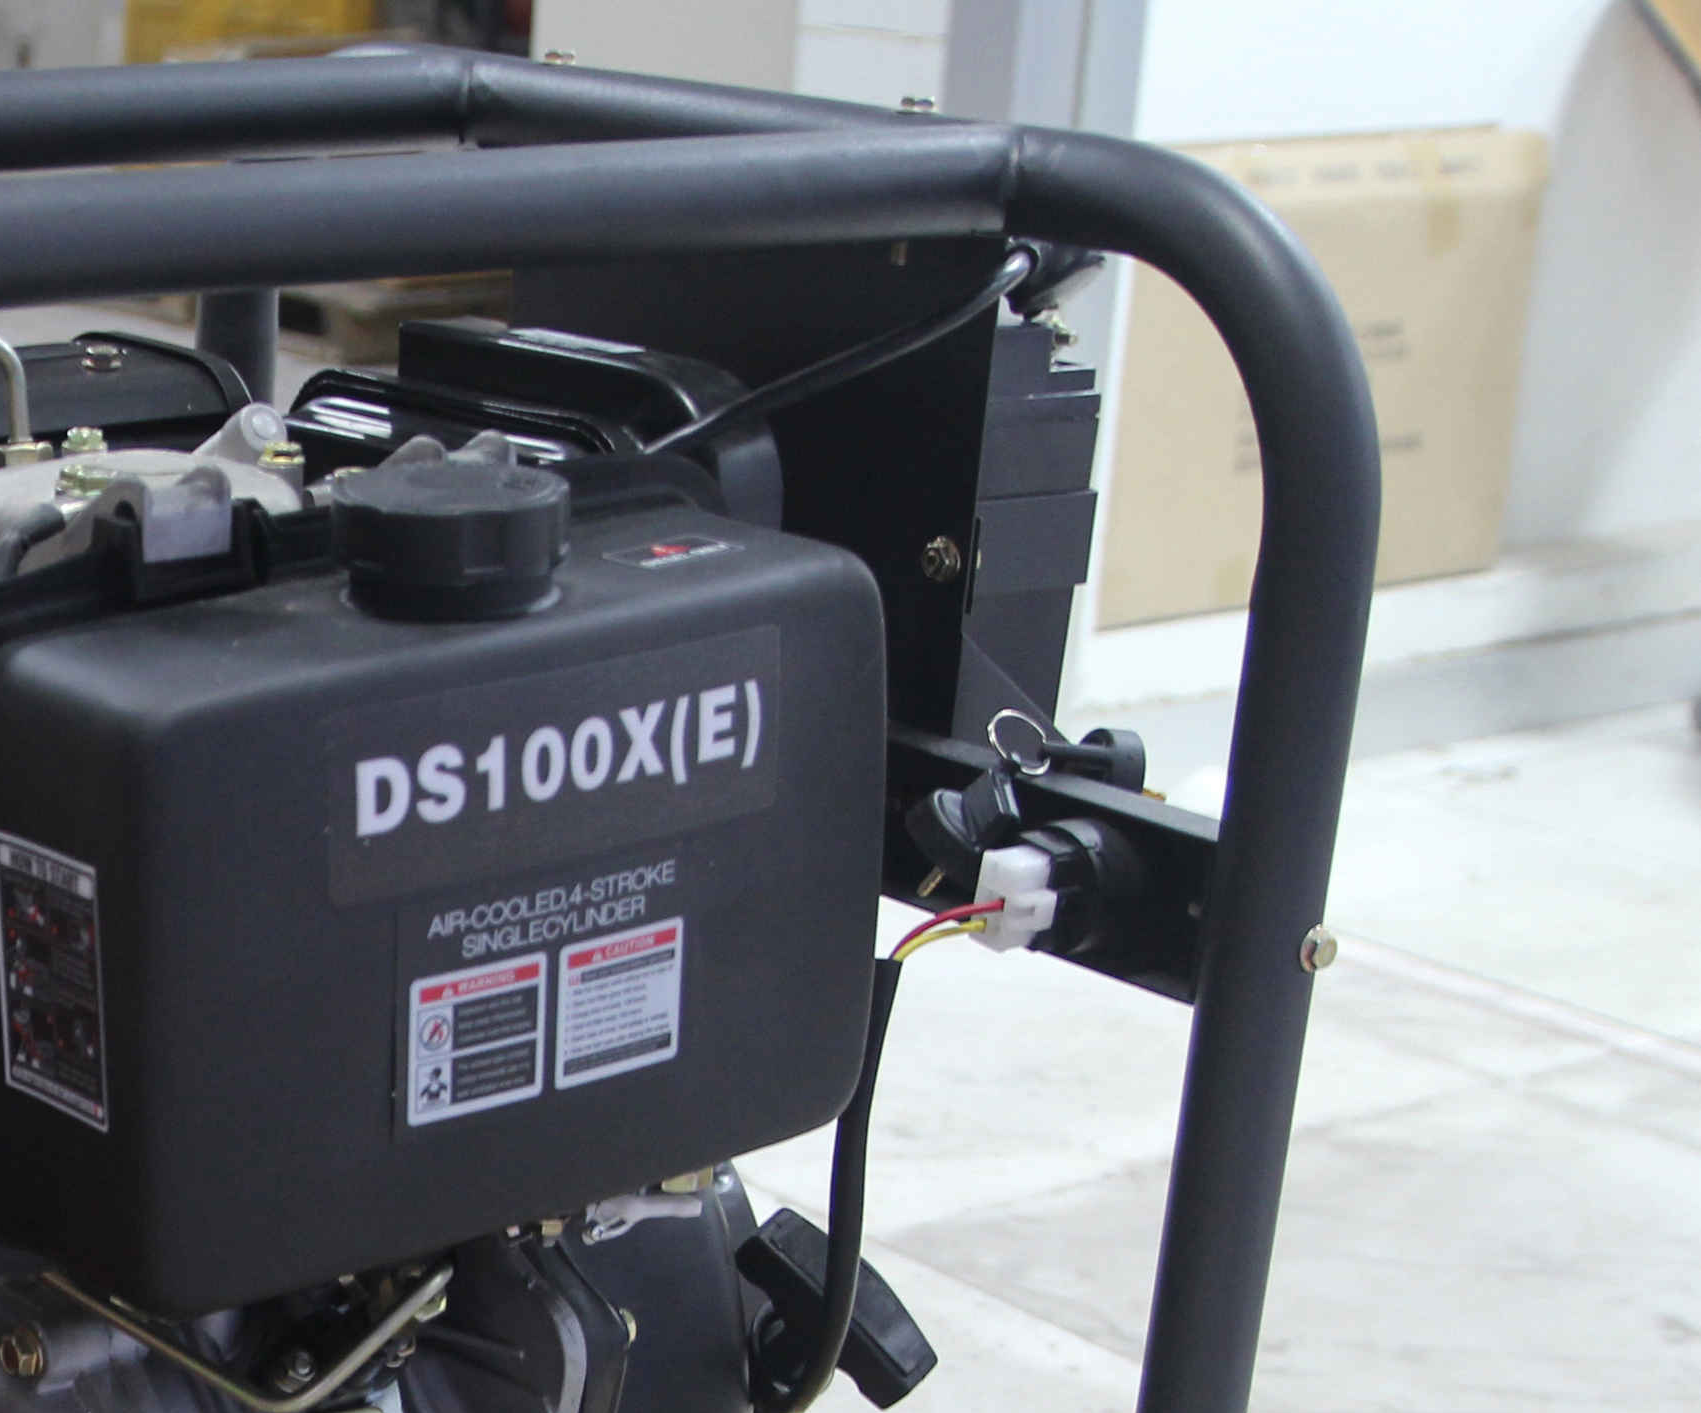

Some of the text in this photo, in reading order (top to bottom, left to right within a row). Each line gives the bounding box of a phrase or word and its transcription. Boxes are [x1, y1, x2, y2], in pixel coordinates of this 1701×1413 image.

[356, 679, 761, 837] DS100X(E)
[605, 935, 656, 958] CAUTION
[457, 968, 516, 994] WARNING
